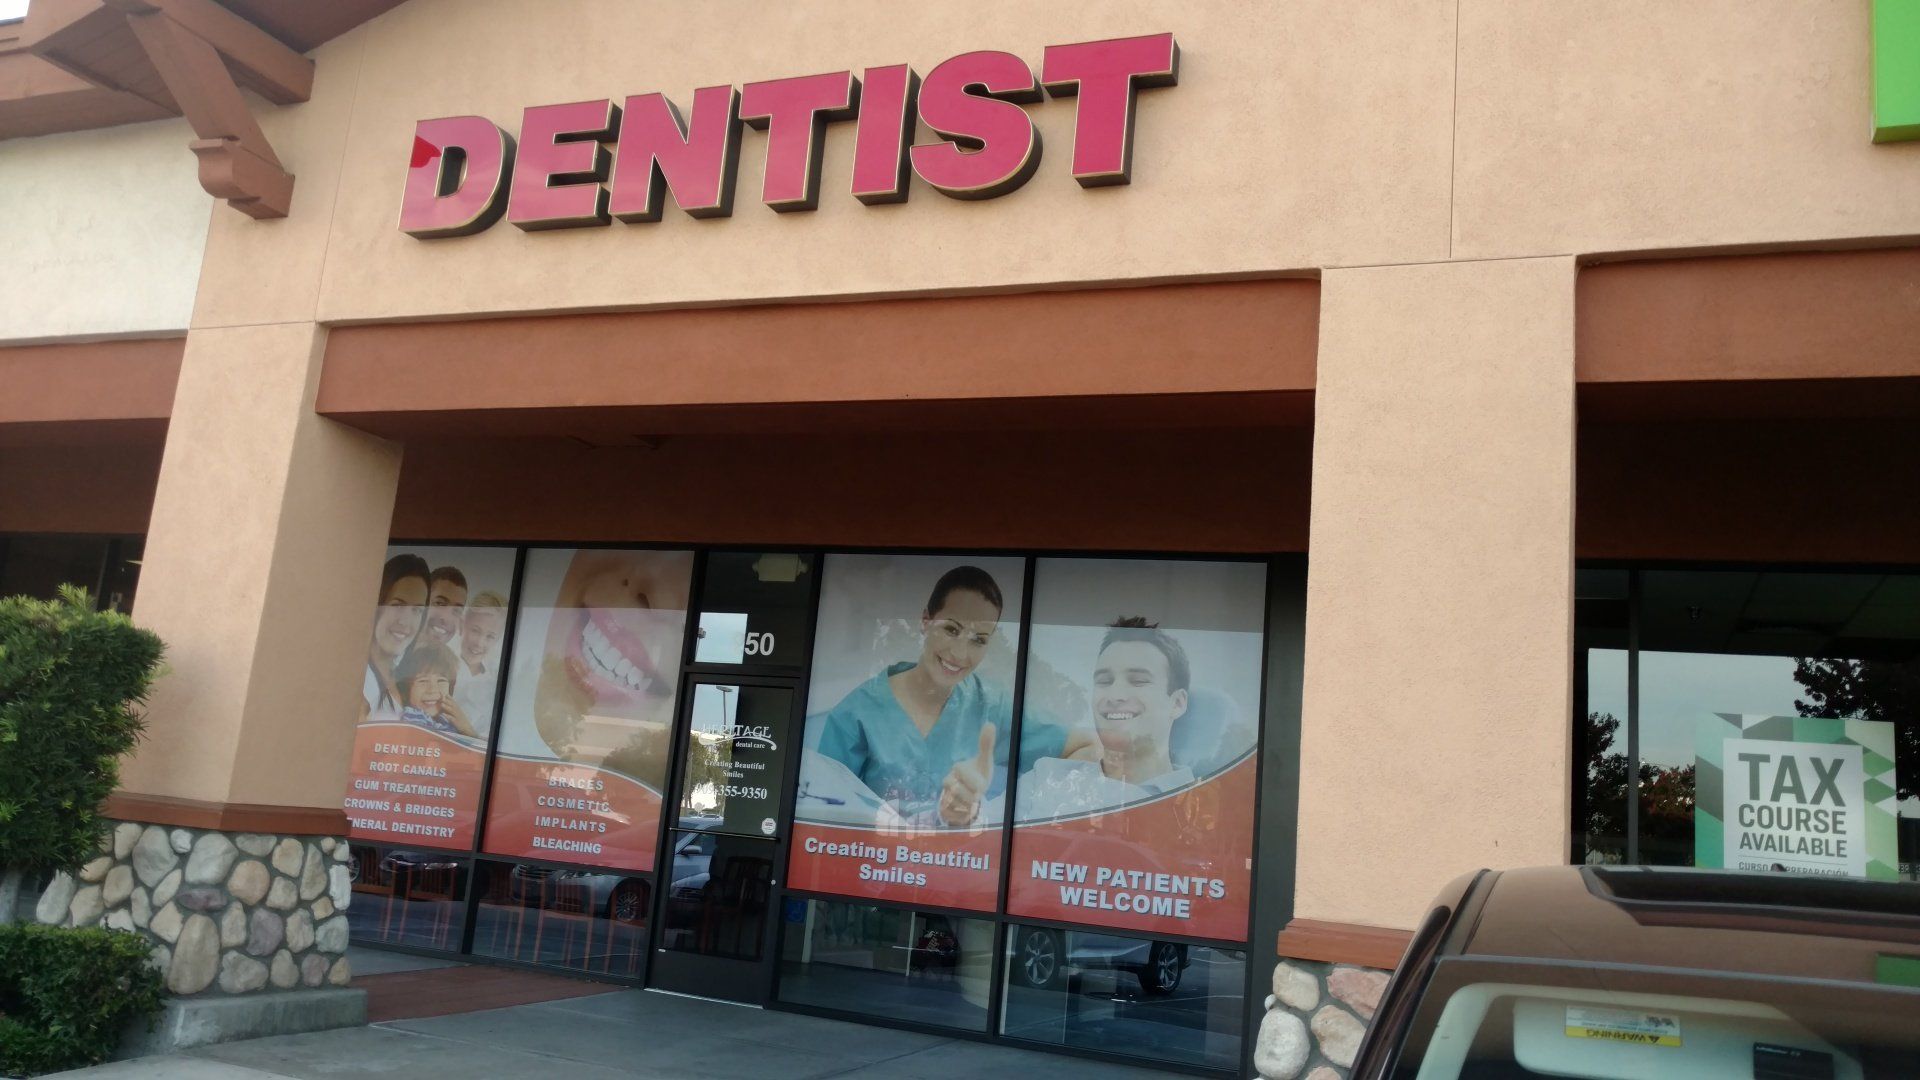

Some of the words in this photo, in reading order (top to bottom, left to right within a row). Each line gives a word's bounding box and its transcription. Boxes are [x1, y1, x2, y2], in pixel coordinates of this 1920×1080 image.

[398, 33, 1178, 239] DENTIST
[374, 743, 441, 758] DENTURES
[736, 741, 753, 749] dental
[369, 761, 400, 773] ROOT
[402, 764, 447, 778] CANALS
[704, 760, 733, 770] Creating
[734, 761, 766, 771] Beautiful
[722, 769, 745, 779] Smiles
[354, 779, 379, 791] GUM
[382, 781, 457, 799] TREATMENTS
[548, 775, 604, 791] BRACES
[1738, 752, 1846, 807] TAX
[344, 797, 390, 812] CROWNS
[393, 802, 401, 813] &
[405, 803, 455, 818] BRIDGES
[537, 796, 609, 812] COSMETIC
[347, 817, 388, 831] NERAL
[391, 822, 456, 838] DENTISTRY
[535, 815, 607, 833] IMPLANTS
[1738, 803, 1846, 835] COURSE
[532, 836, 602, 854] BLEACHING
[804, 837, 889, 863] Creating
[895, 845, 990, 871] Beautiful
[1739, 832, 1847, 858] AVAILABLE
[858, 863, 928, 887] Smiles
[1738, 861, 1770, 872] CURSO
[1031, 859, 1087, 884] NEW
[1096, 867, 1226, 899] PATIENTS
[1060, 885, 1191, 919] WELCOME
